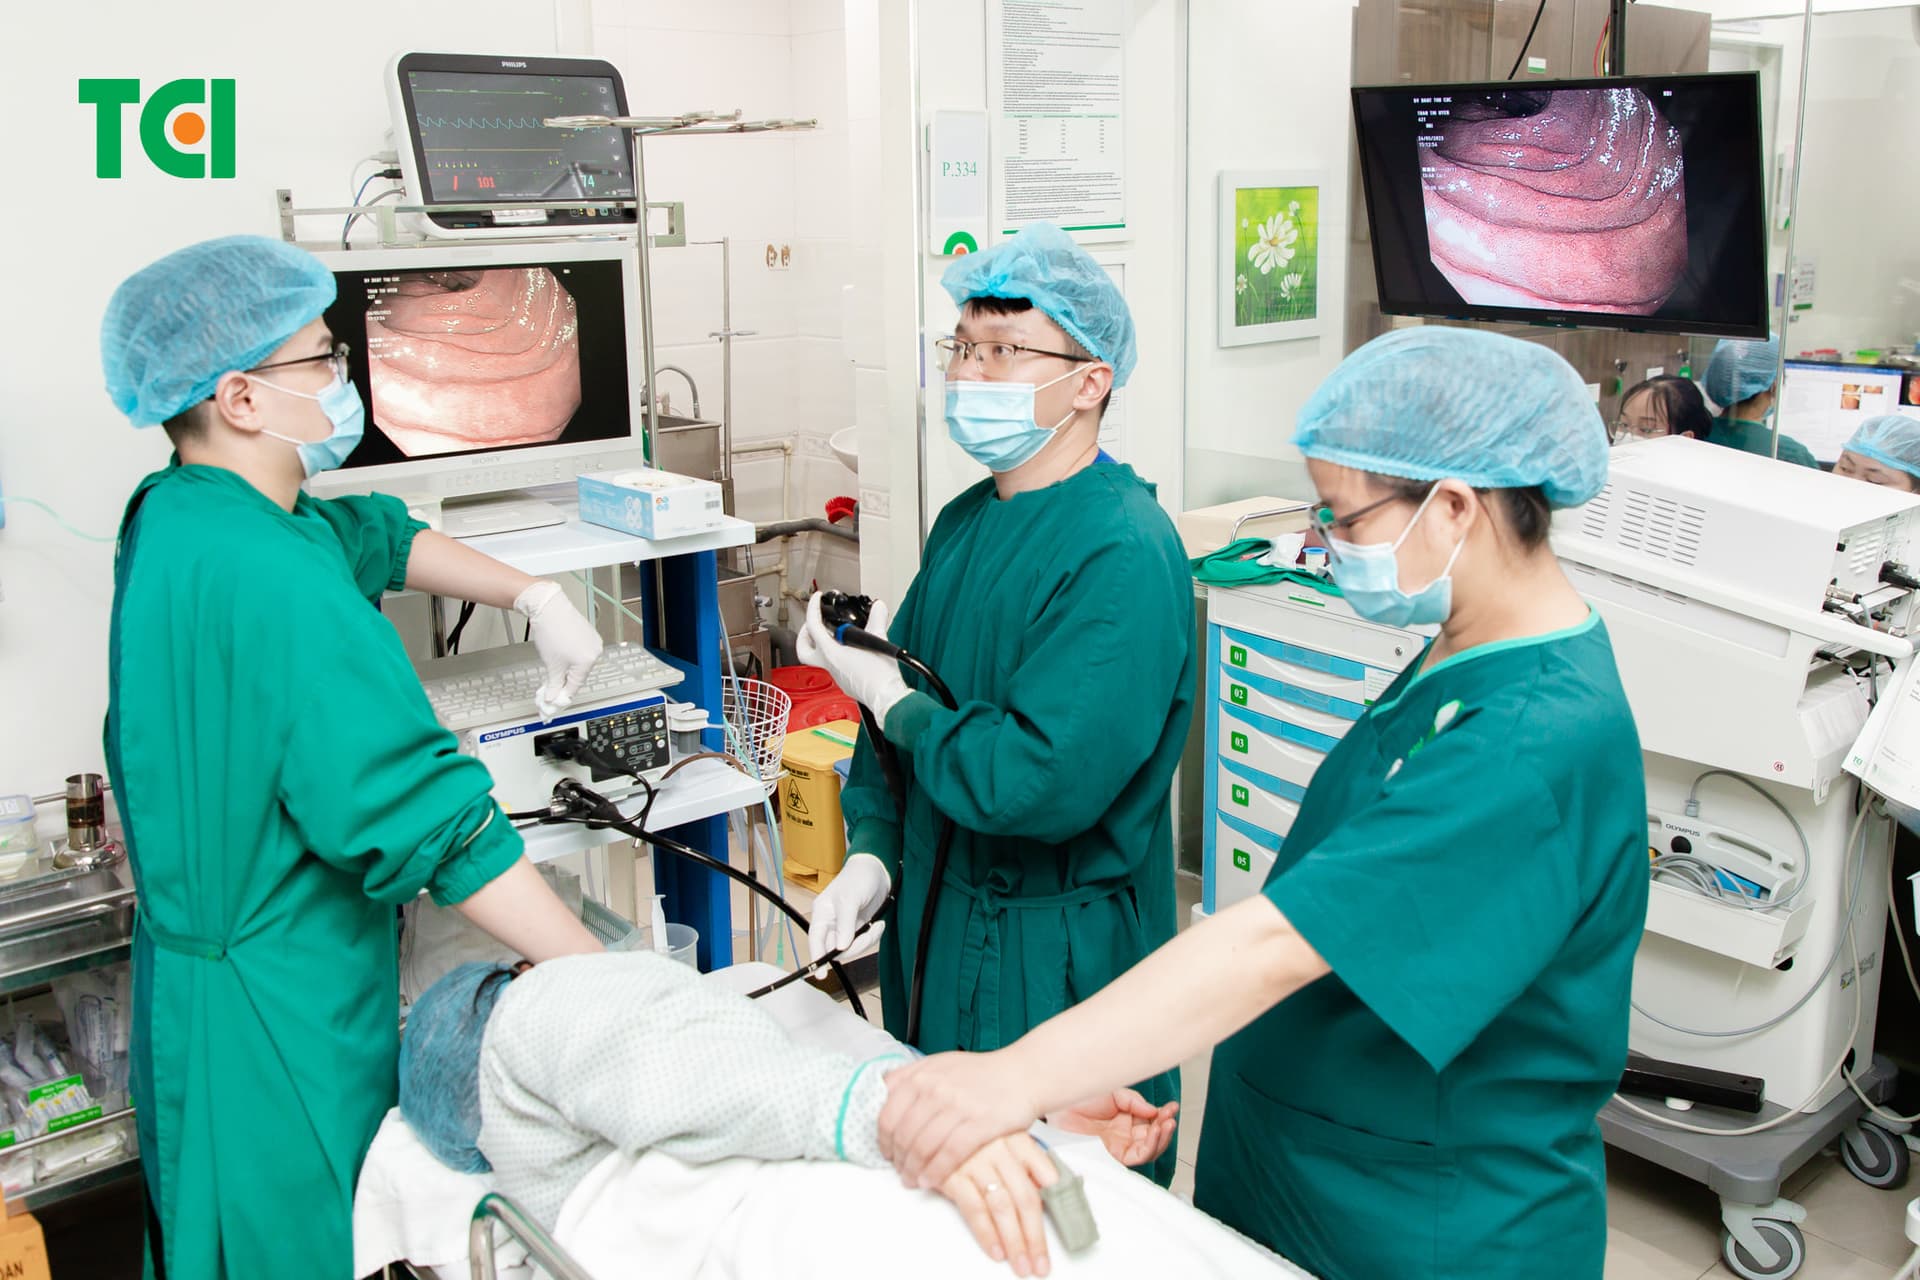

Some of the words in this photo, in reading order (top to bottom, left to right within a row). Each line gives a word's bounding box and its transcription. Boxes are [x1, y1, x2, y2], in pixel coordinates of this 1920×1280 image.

[501, 61, 527, 69] PHILIPS
[943, 161, 977, 177] P.334
[477, 176, 497, 189] 101
[1233, 650, 1244, 662] 01
[1234, 689, 1244, 699] 02
[484, 726, 526, 741] OLYMPUS
[1235, 737, 1245, 748] 03
[1235, 789, 1246, 800] 04
[1665, 823, 1701, 837] OLYMPUS
[1237, 855, 1247, 866] 05
